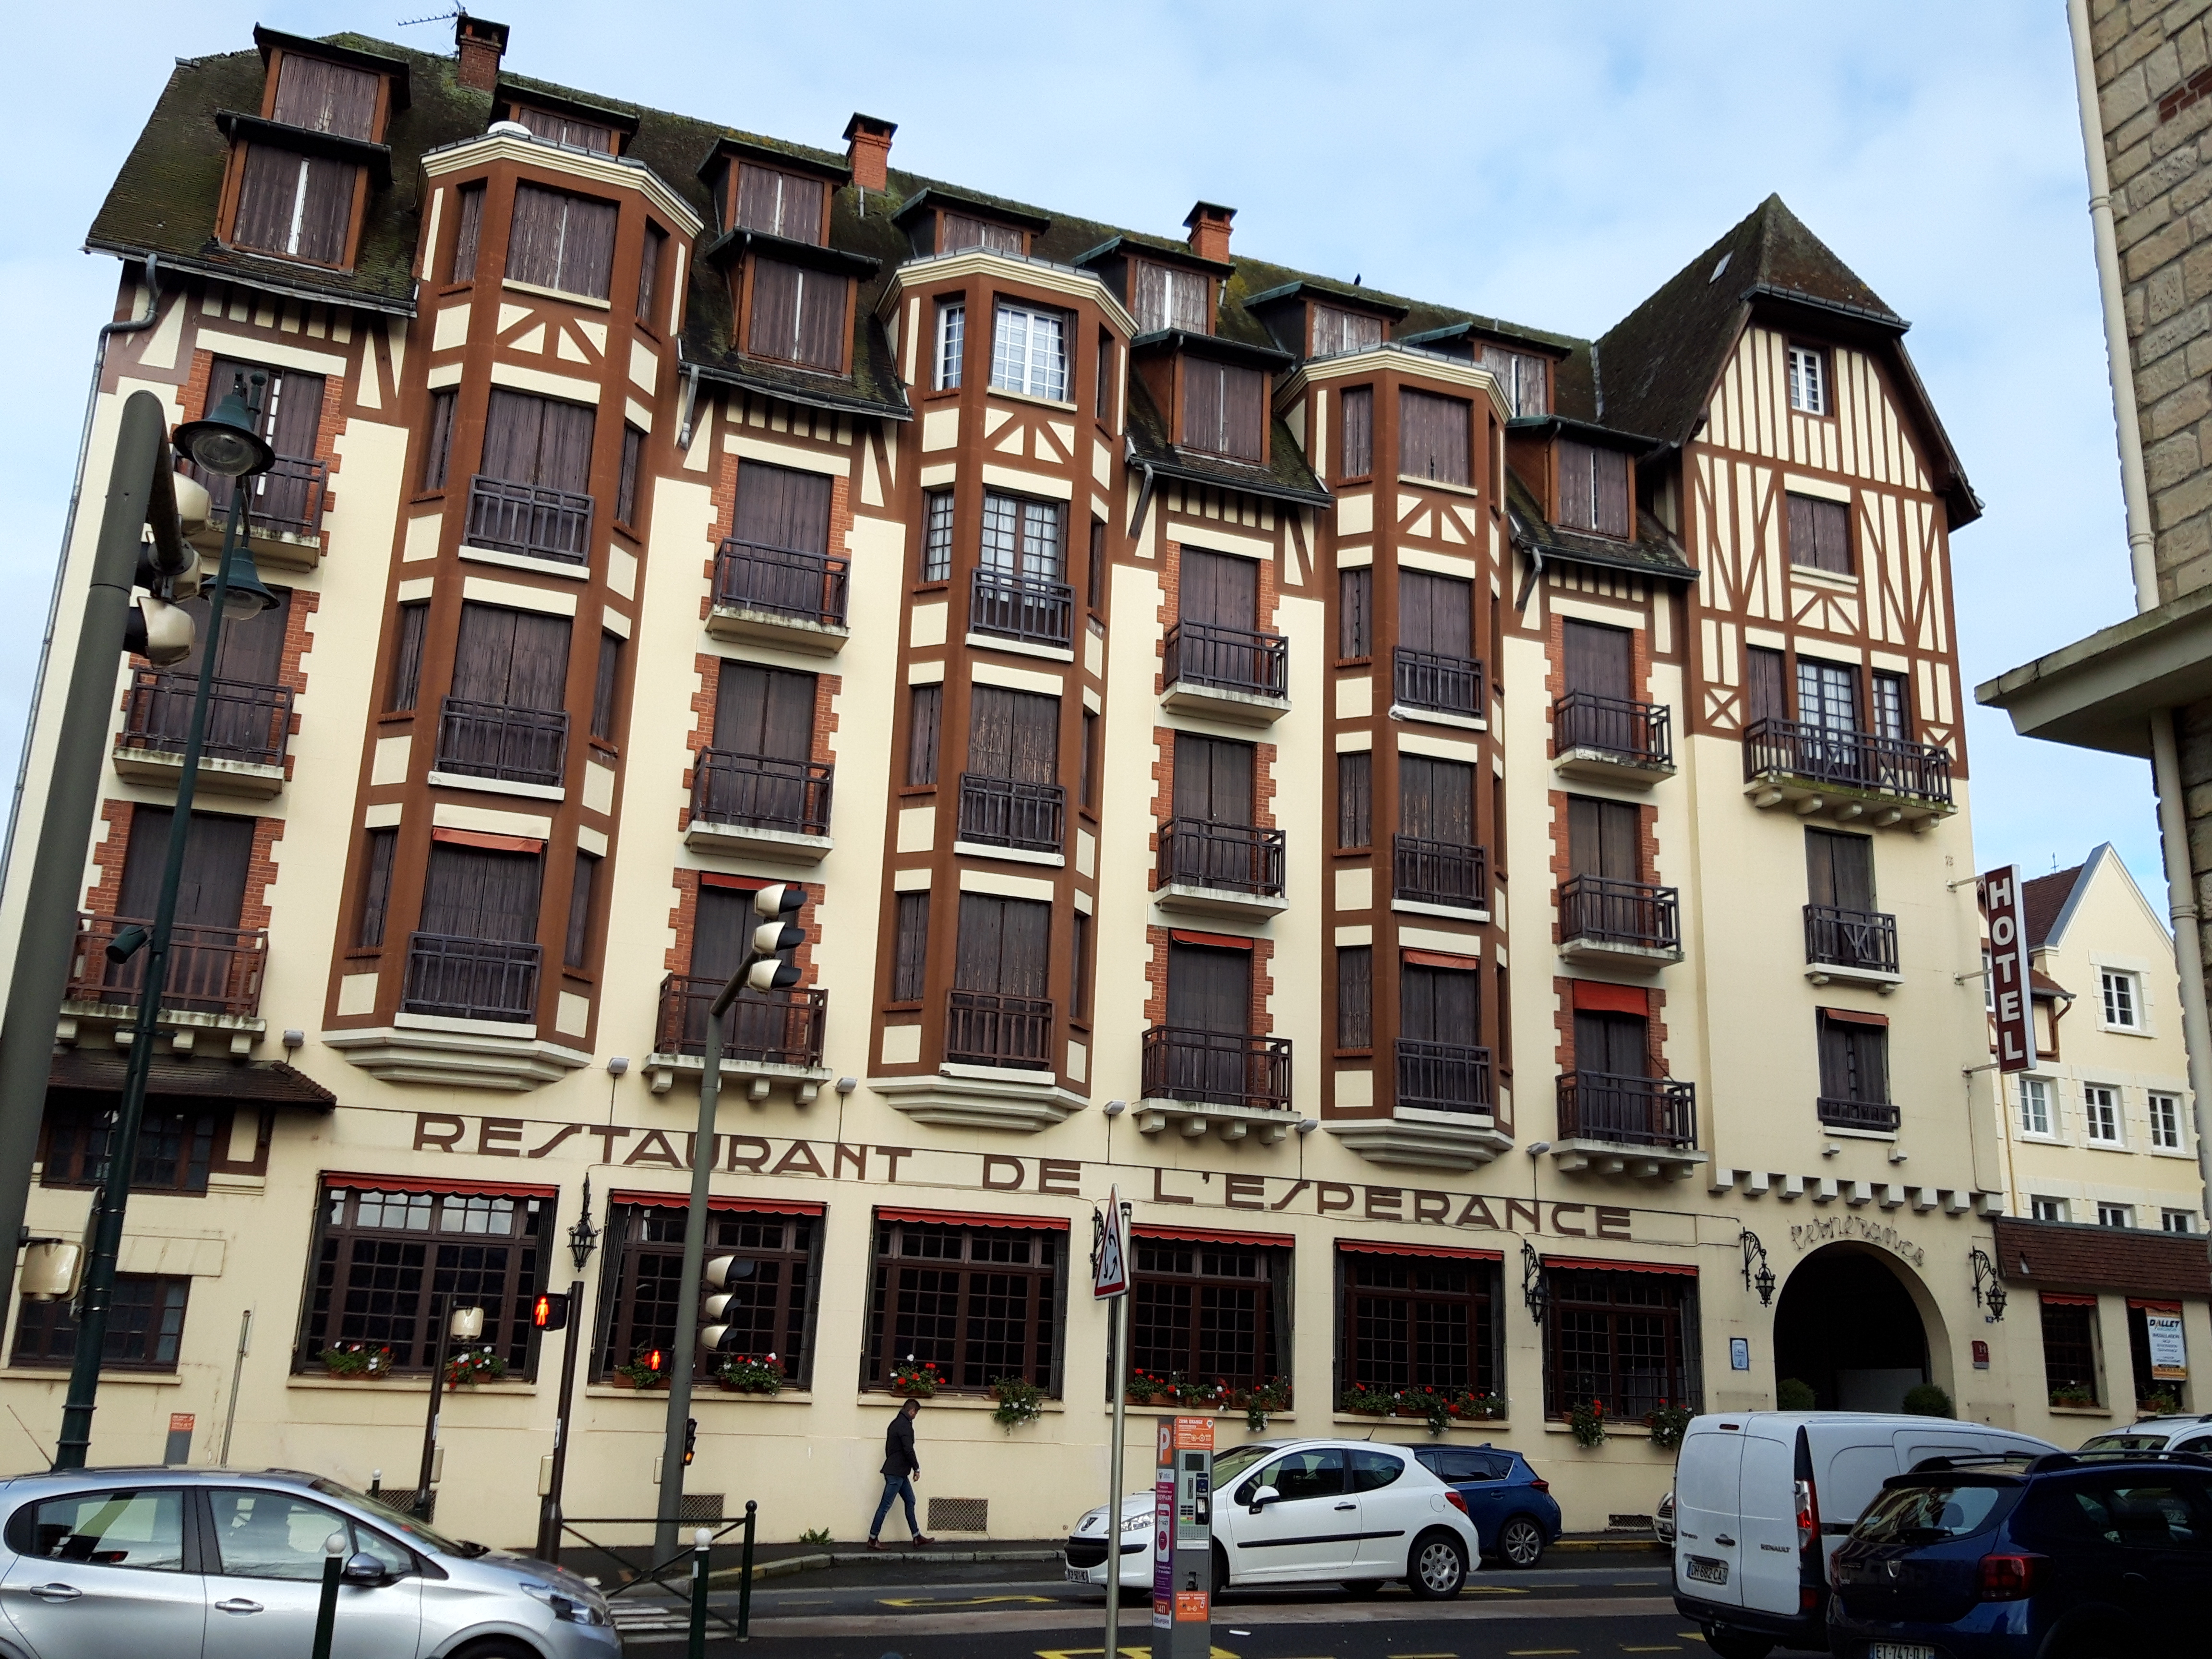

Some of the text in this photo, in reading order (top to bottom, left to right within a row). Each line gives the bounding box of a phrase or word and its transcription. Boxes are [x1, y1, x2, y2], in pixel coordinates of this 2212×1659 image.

[1989, 877, 2023, 1061] HOTEL
[413, 1112, 1632, 1240] RESTAURANT DE L'ESPERANCE
[2150, 1319, 2180, 1328] DALLET
[1159, 1427, 1170, 1461] P
[1760, 1543, 1791, 1553] RENAULT
